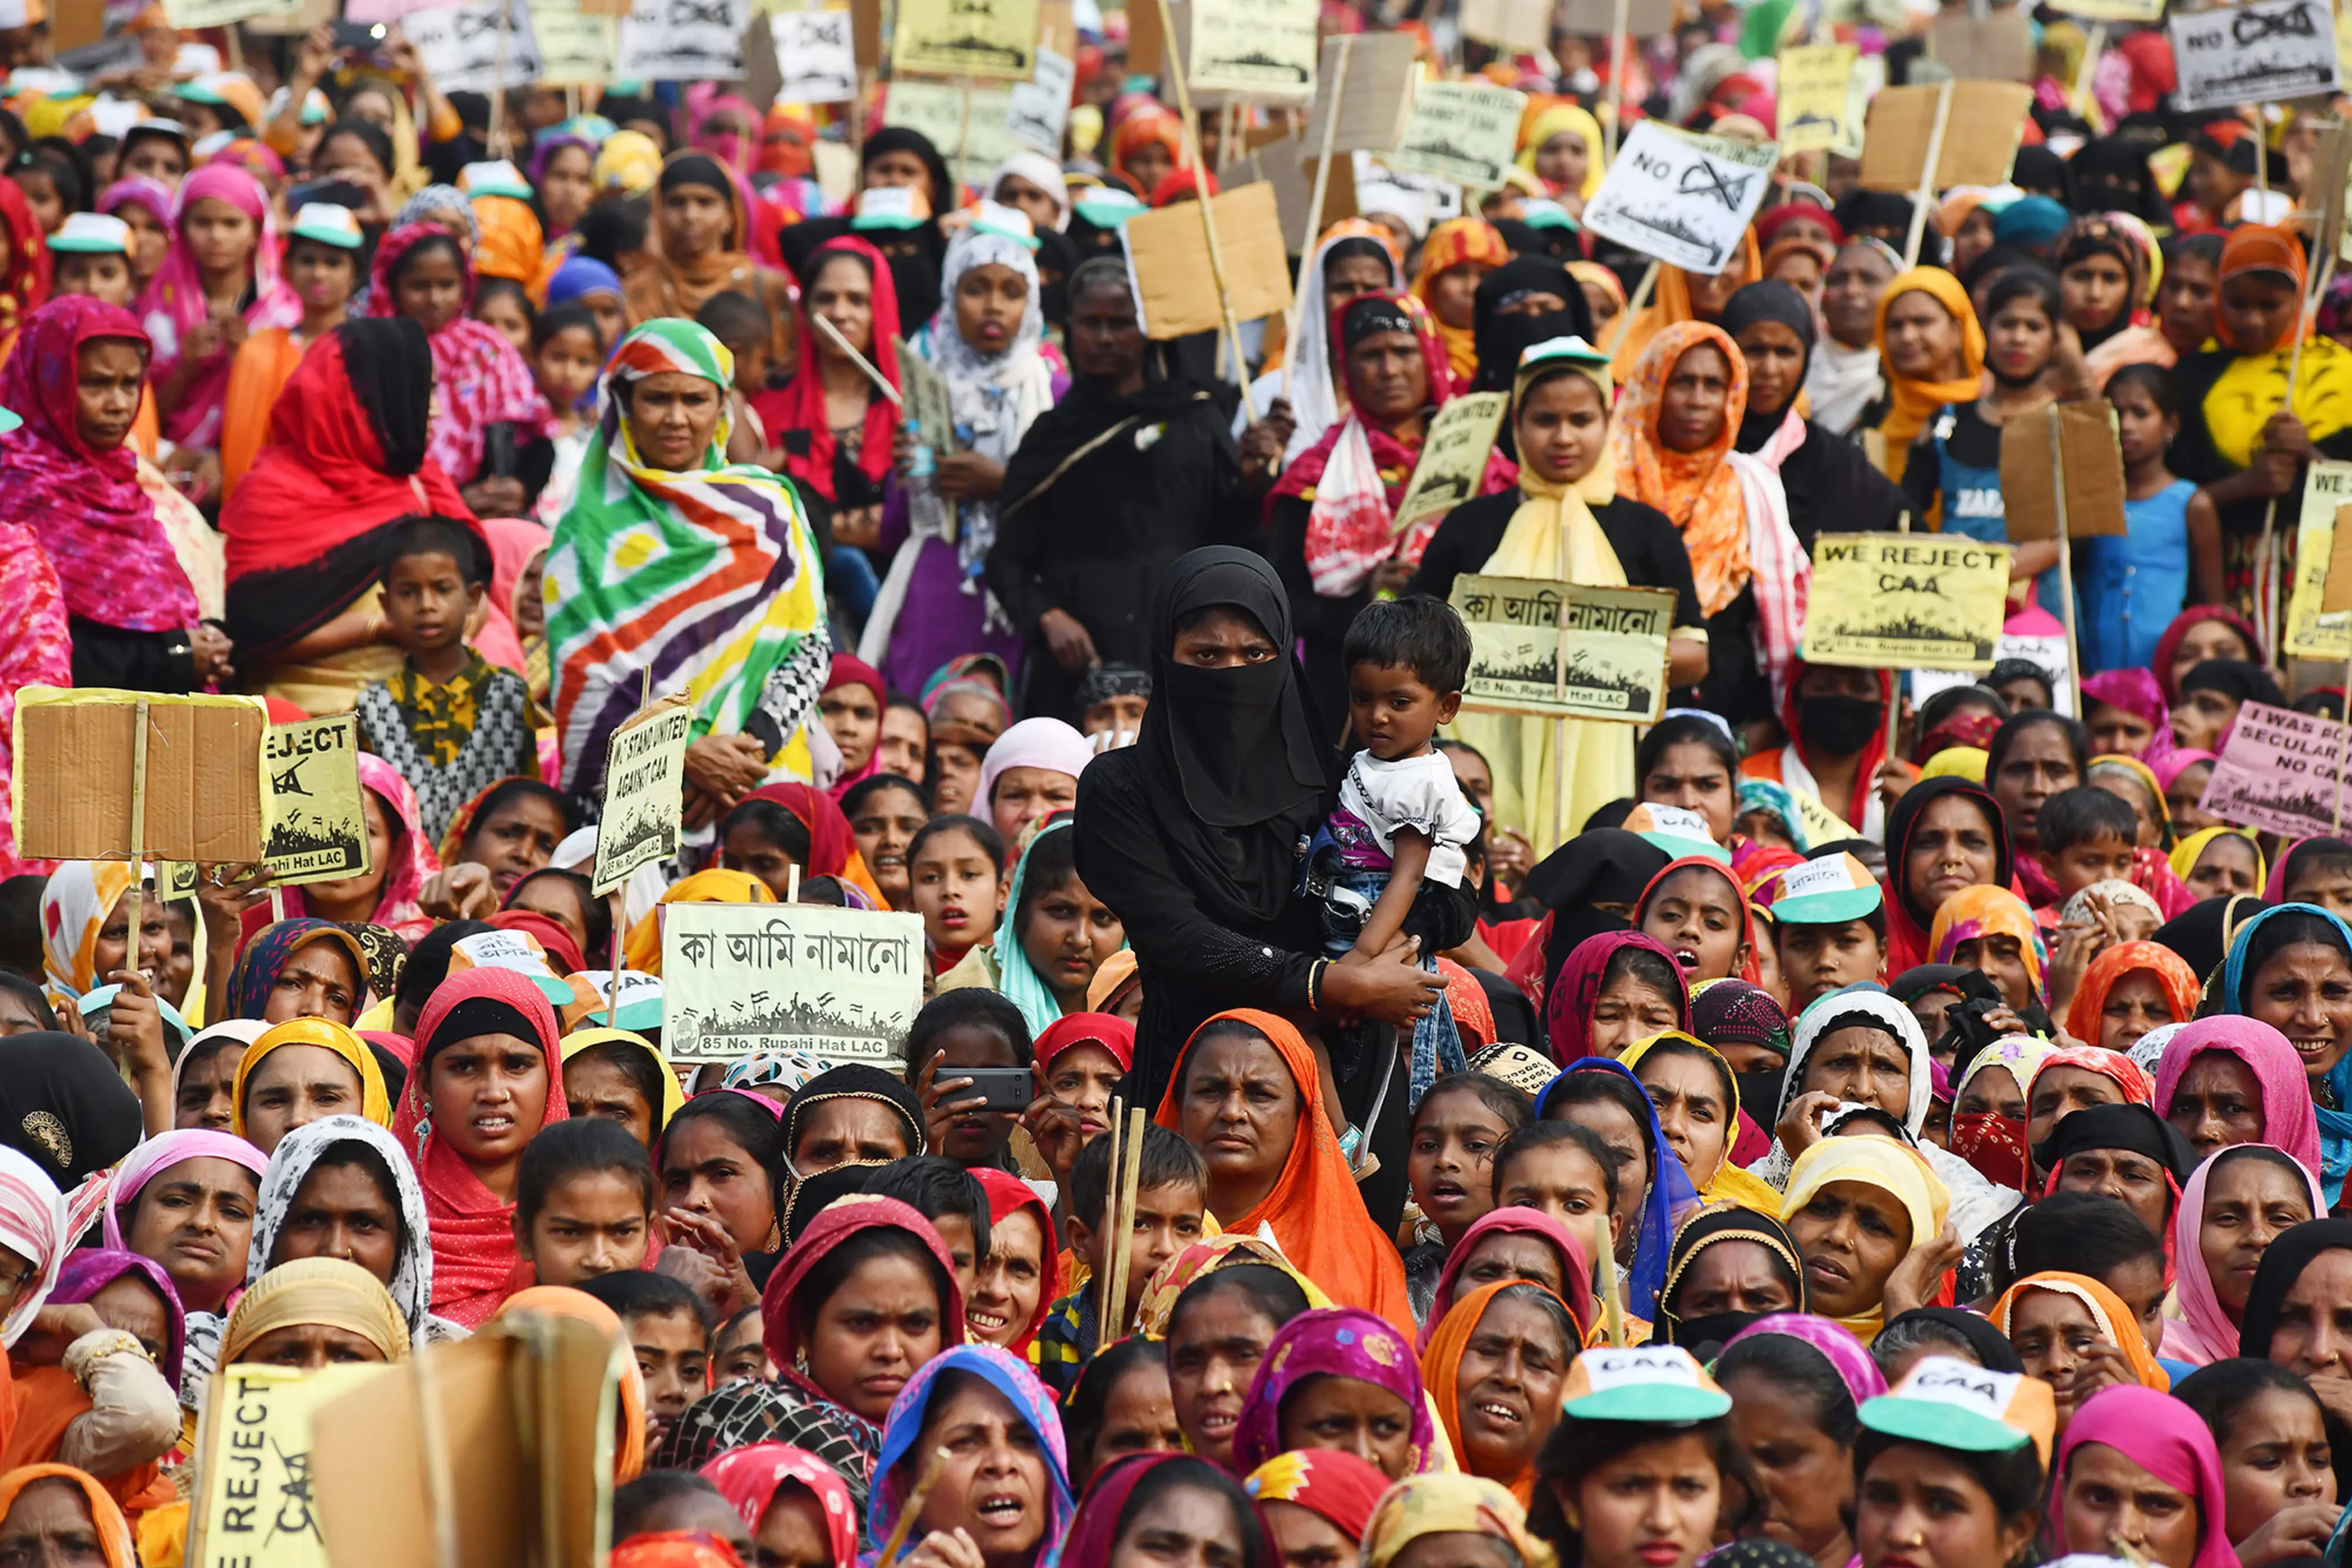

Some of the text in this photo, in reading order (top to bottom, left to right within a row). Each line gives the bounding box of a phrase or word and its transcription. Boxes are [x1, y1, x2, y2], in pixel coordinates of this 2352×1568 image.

[1632, 151, 1670, 179] NO
[2315, 473, 2343, 492] WE
[1824, 545, 2002, 570] WE REJECT
[1879, 574, 1941, 594] CAA
[1464, 589, 1658, 635] কা আমি নামানো
[1520, 684, 1567, 700] Rupa
[1597, 693, 1625, 706] LAC
[2267, 711, 2315, 734] WAS
[2239, 724, 2339, 760] SECULAR
[650, 755, 668, 784] CAA
[2275, 755, 2307, 773] NO
[293, 856, 314, 869] Hat
[318, 851, 342, 865] LAC
[679, 918, 911, 976] কা আমি নামানো
[603, 976, 660, 996] CAA
[703, 1037, 883, 1054] 85 No. Rupahi Hat LAC
[1602, 1357, 1689, 1372] CAA
[1917, 1371, 1997, 1403] CAA
[222, 1378, 270, 1532] REJECT
